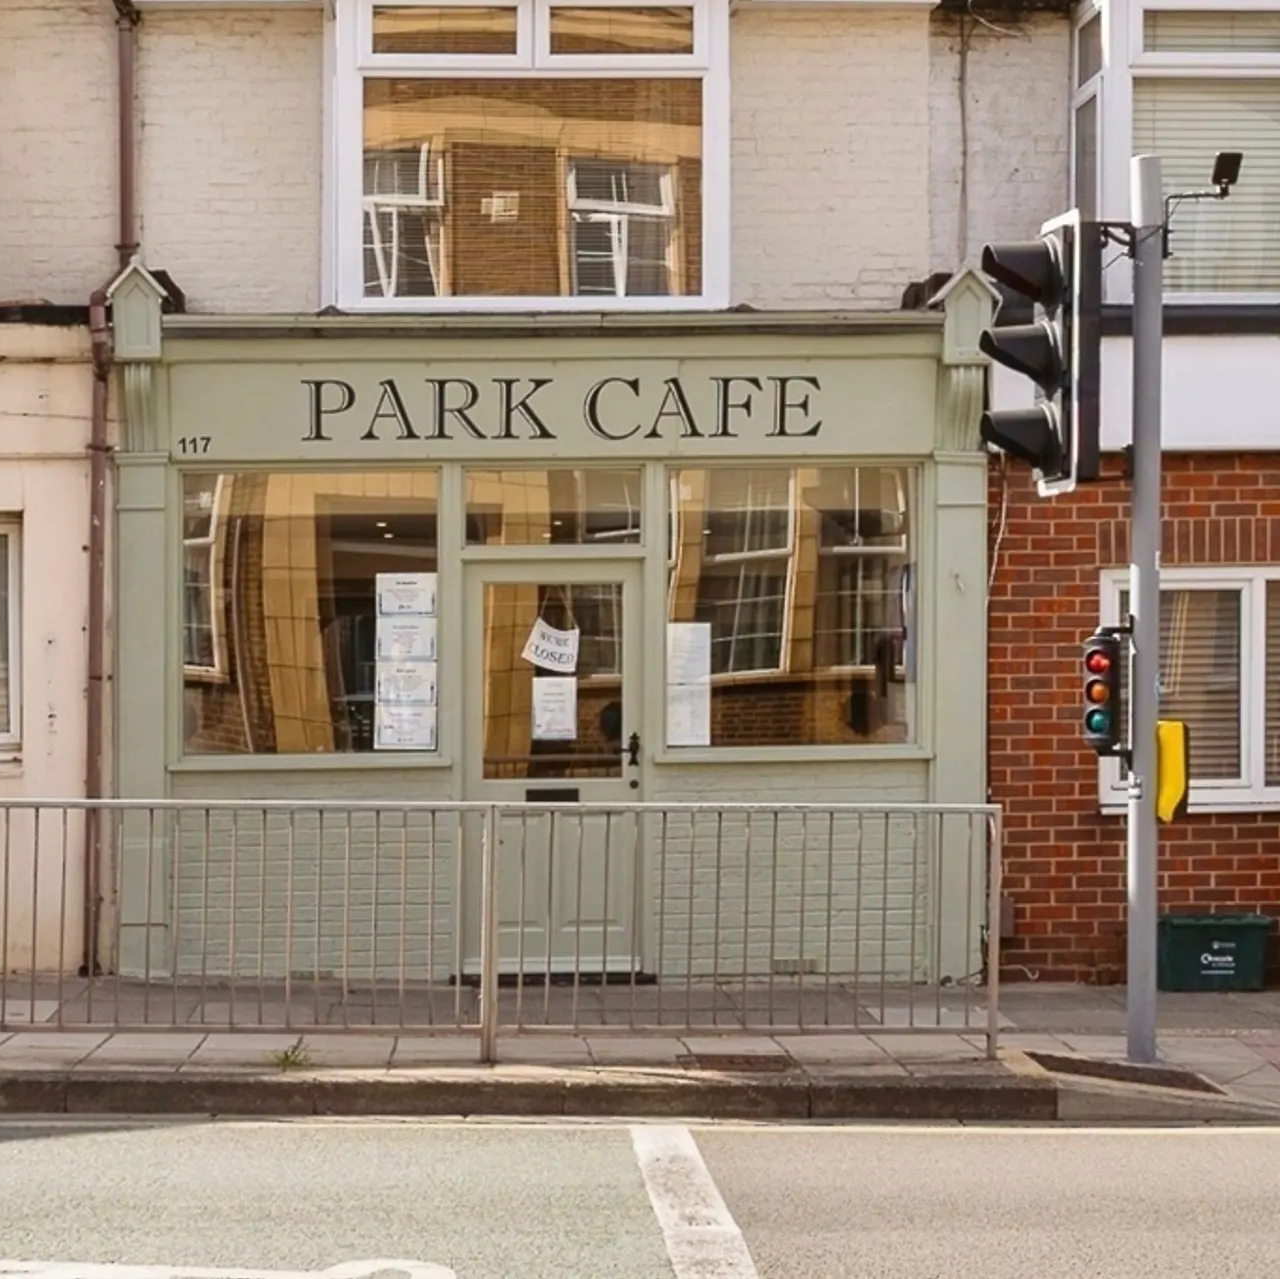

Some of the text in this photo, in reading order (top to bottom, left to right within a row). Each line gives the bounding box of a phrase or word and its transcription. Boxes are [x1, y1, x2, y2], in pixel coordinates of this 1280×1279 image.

[300, 376, 823, 441] PARK CAFE
[178, 436, 212, 454] 117
[528, 642, 574, 665] CLOSED
